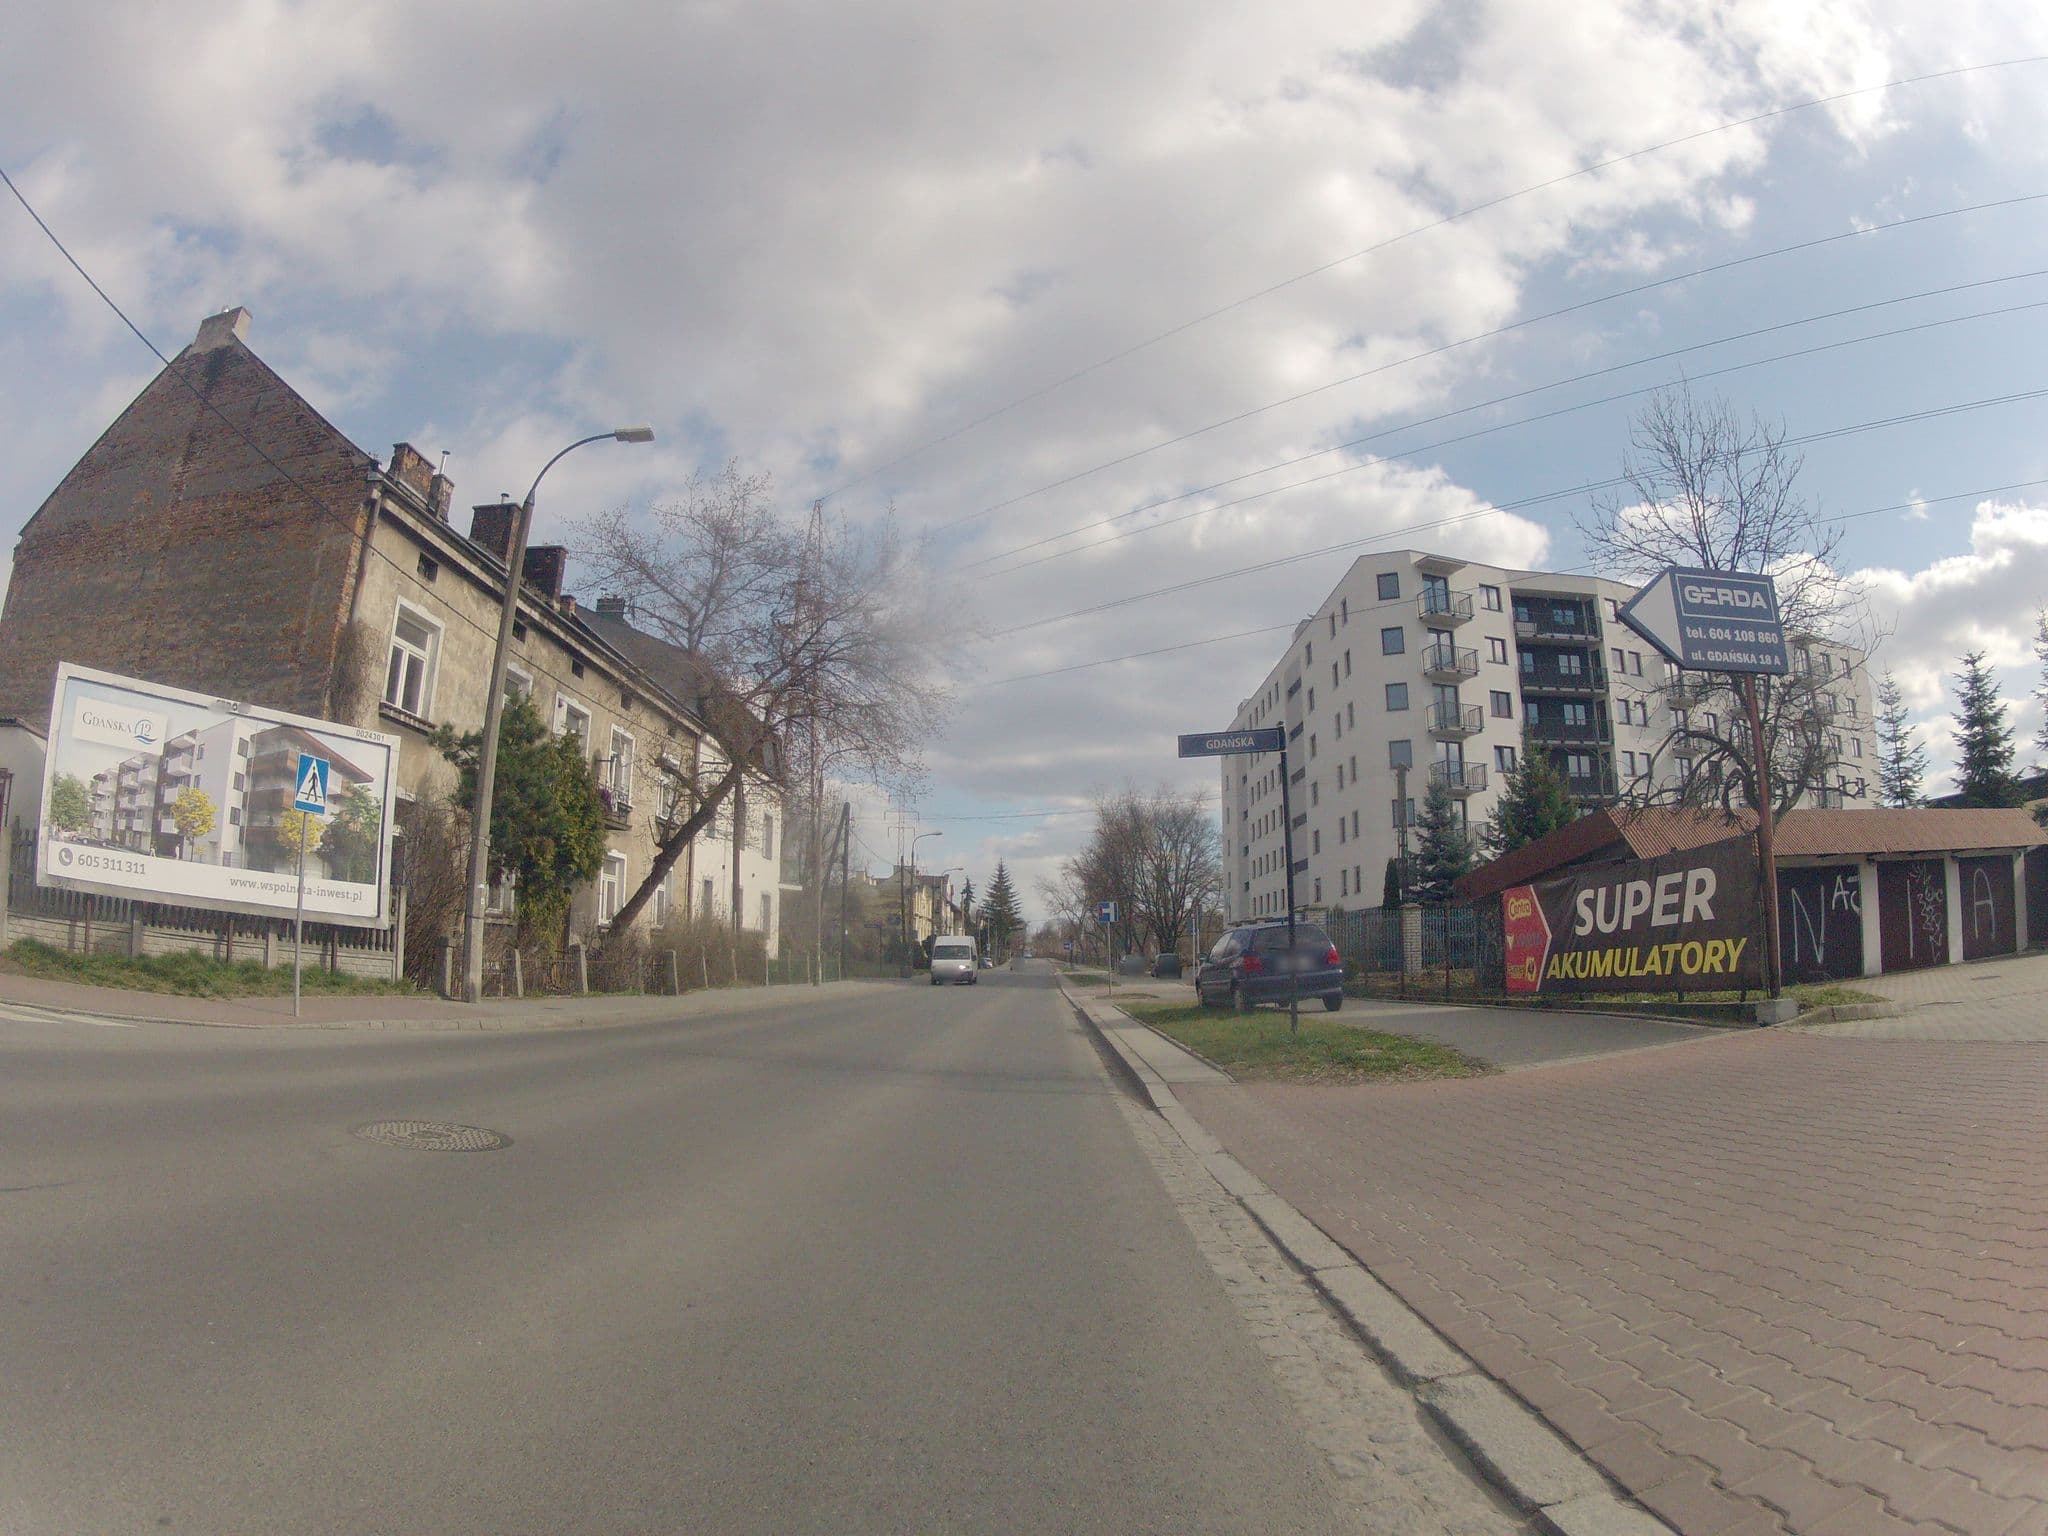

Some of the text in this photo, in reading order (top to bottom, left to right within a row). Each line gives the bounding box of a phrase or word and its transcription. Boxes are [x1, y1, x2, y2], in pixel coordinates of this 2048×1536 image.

[1684, 585, 1767, 609] GERDA
[1686, 626, 1779, 644] tel. 604 108 860
[1691, 650, 1705, 661] ul.
[1759, 655, 1772, 665] 18
[1774, 656, 1781, 666] A
[78, 854, 146, 875] 605 311 311
[1575, 867, 1717, 936] SUPER
[1546, 937, 1748, 979] AKUMULATORY
